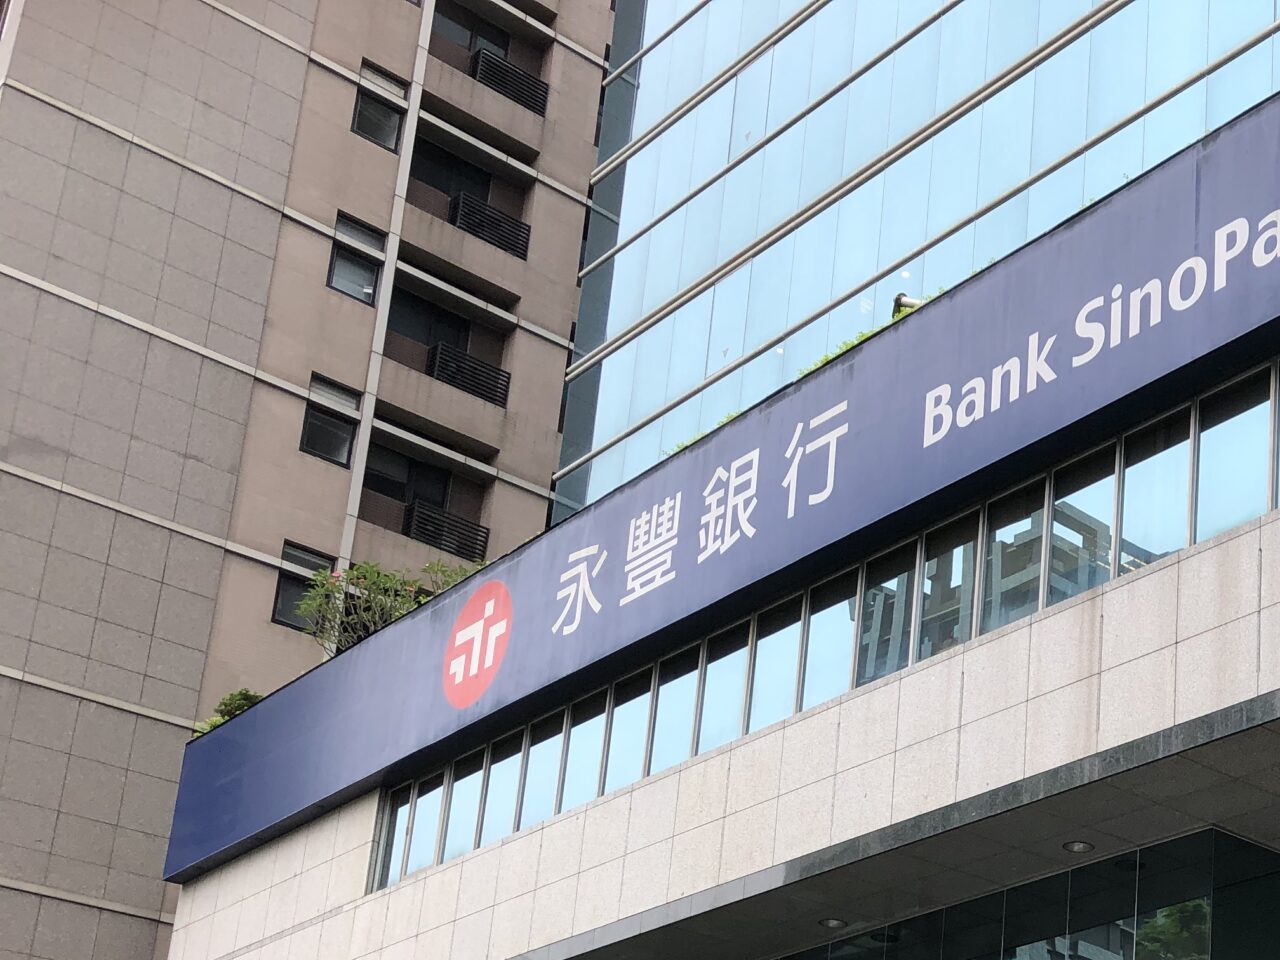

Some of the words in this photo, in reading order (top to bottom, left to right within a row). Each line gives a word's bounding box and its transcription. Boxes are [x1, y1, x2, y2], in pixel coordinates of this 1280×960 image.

[551, 399, 849, 636] 永豐銀行
[923, 331, 1058, 449] Bank
